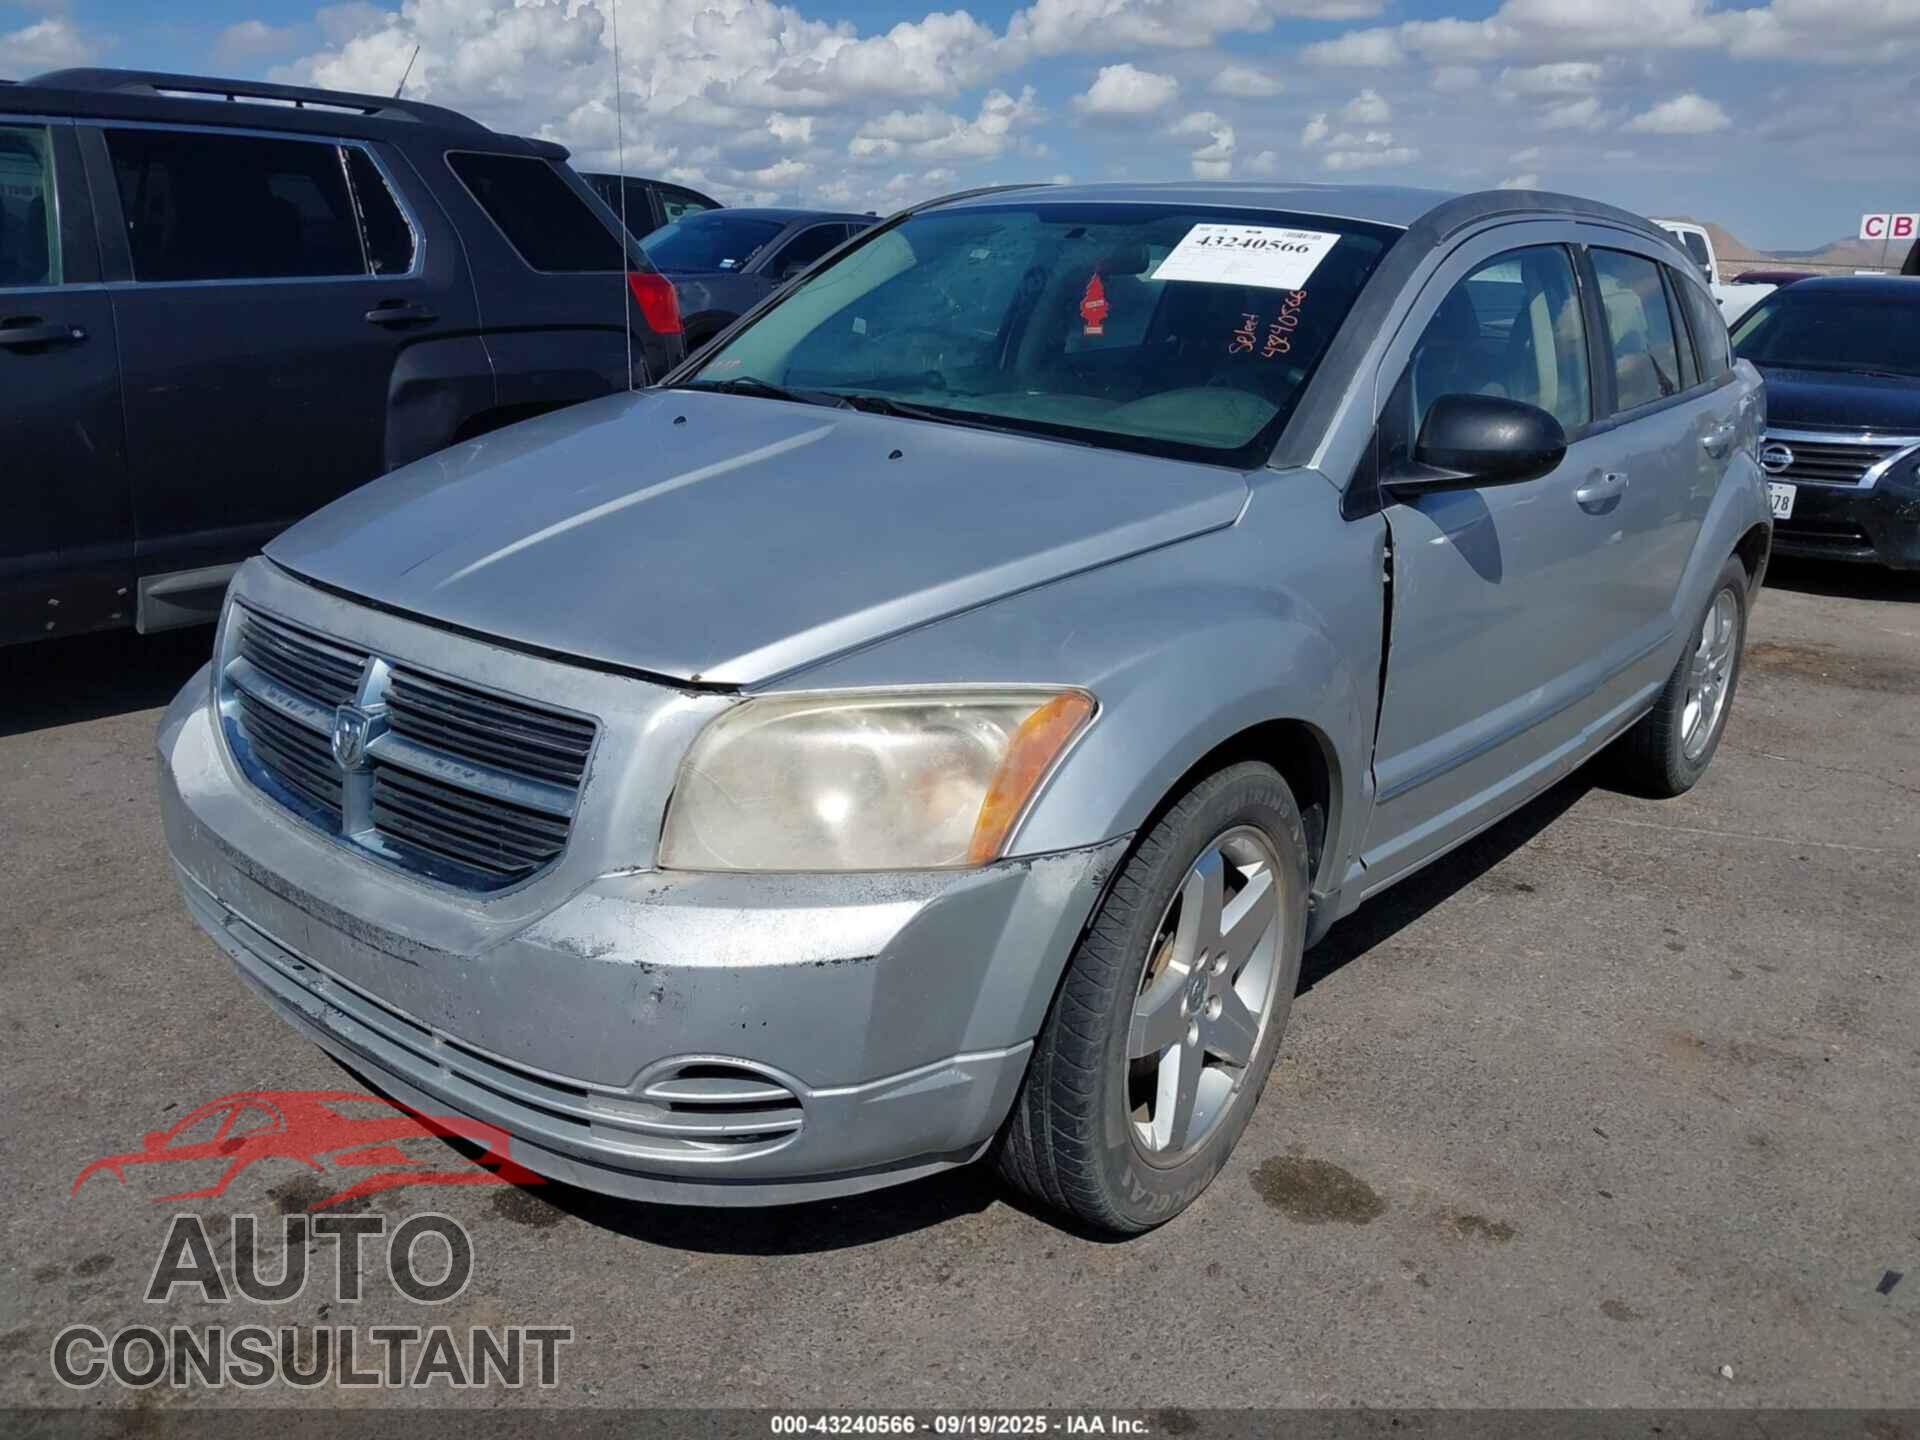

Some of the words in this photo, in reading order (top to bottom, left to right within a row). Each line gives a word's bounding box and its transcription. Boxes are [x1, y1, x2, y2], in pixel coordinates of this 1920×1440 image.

[1865, 217, 1884, 237] C
[1893, 217, 1912, 237] B
[1196, 234, 1310, 255] 43240566
